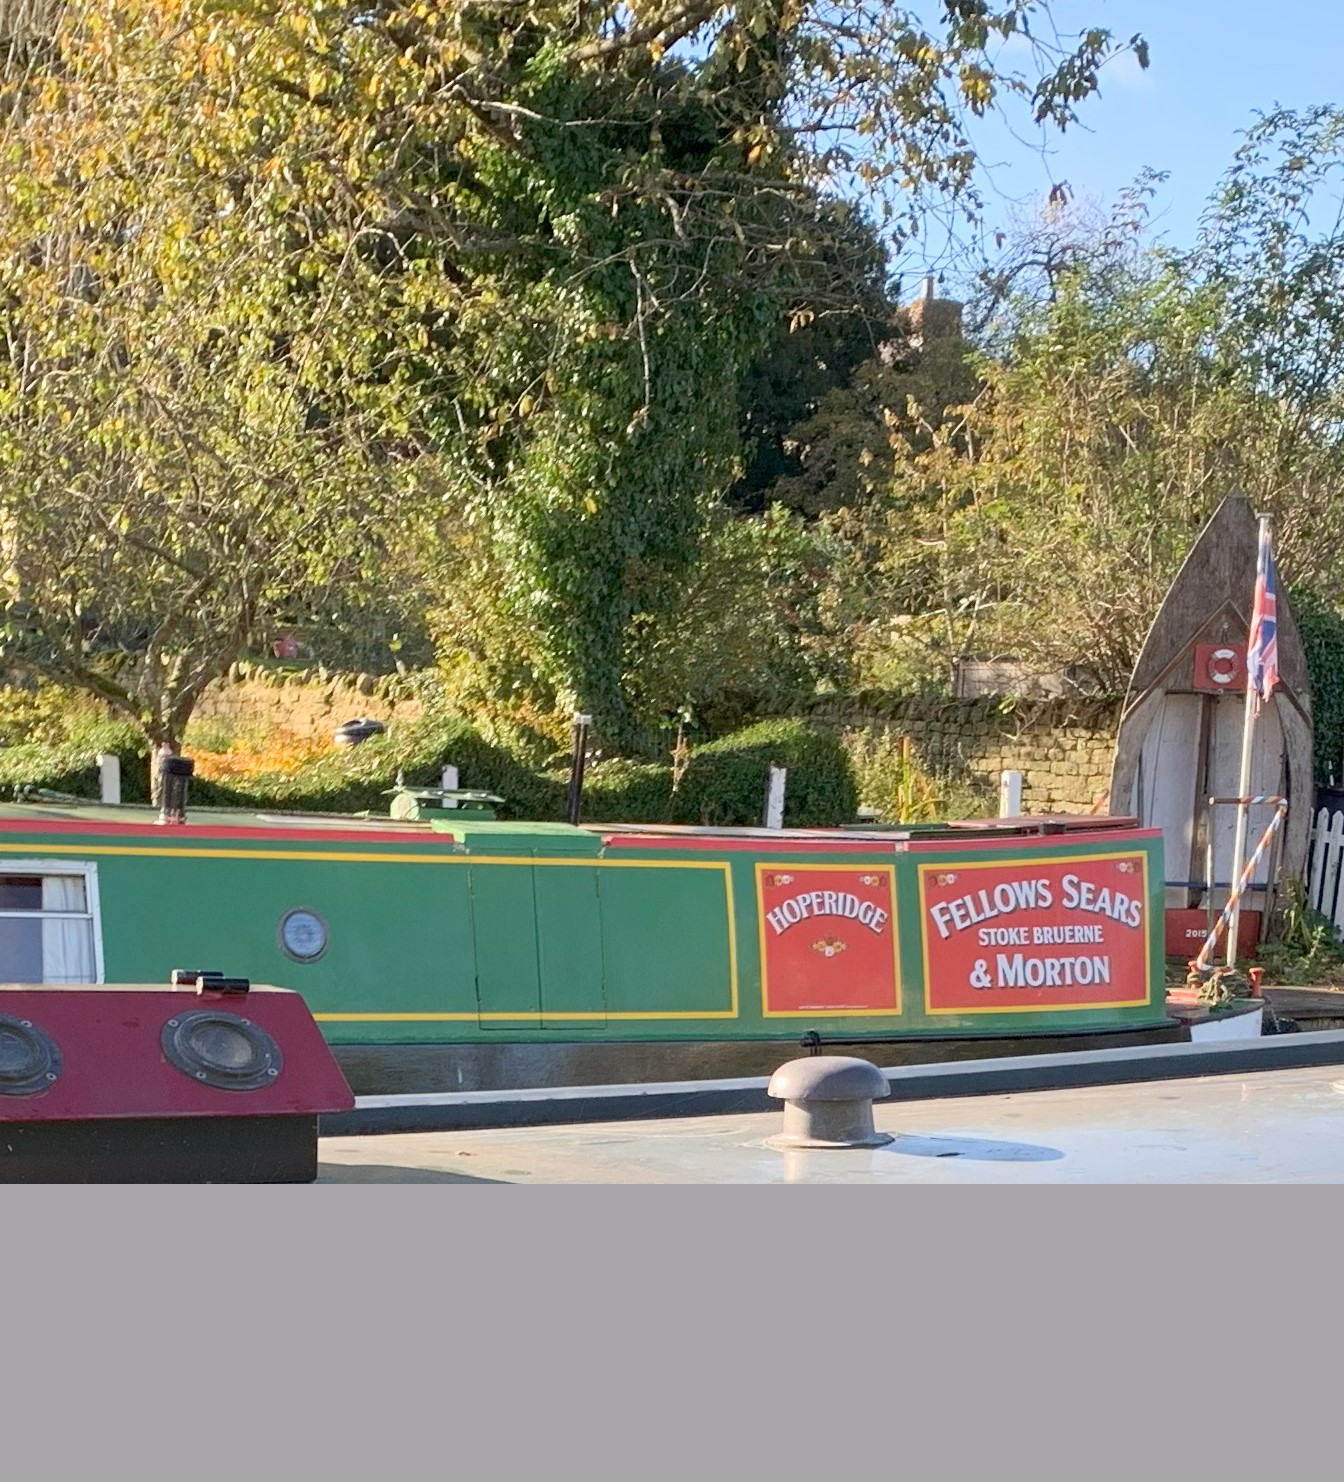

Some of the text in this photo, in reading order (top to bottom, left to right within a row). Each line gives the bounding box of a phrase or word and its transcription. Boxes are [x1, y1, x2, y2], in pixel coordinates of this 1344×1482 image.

[766, 890, 888, 935] HOPERIDGE
[930, 874, 1142, 939] FELLOWS SEARS
[978, 925, 1104, 946] STOKE BRUERNE
[1185, 929, 1207, 938] 2015
[969, 954, 1110, 989] & MORTON
